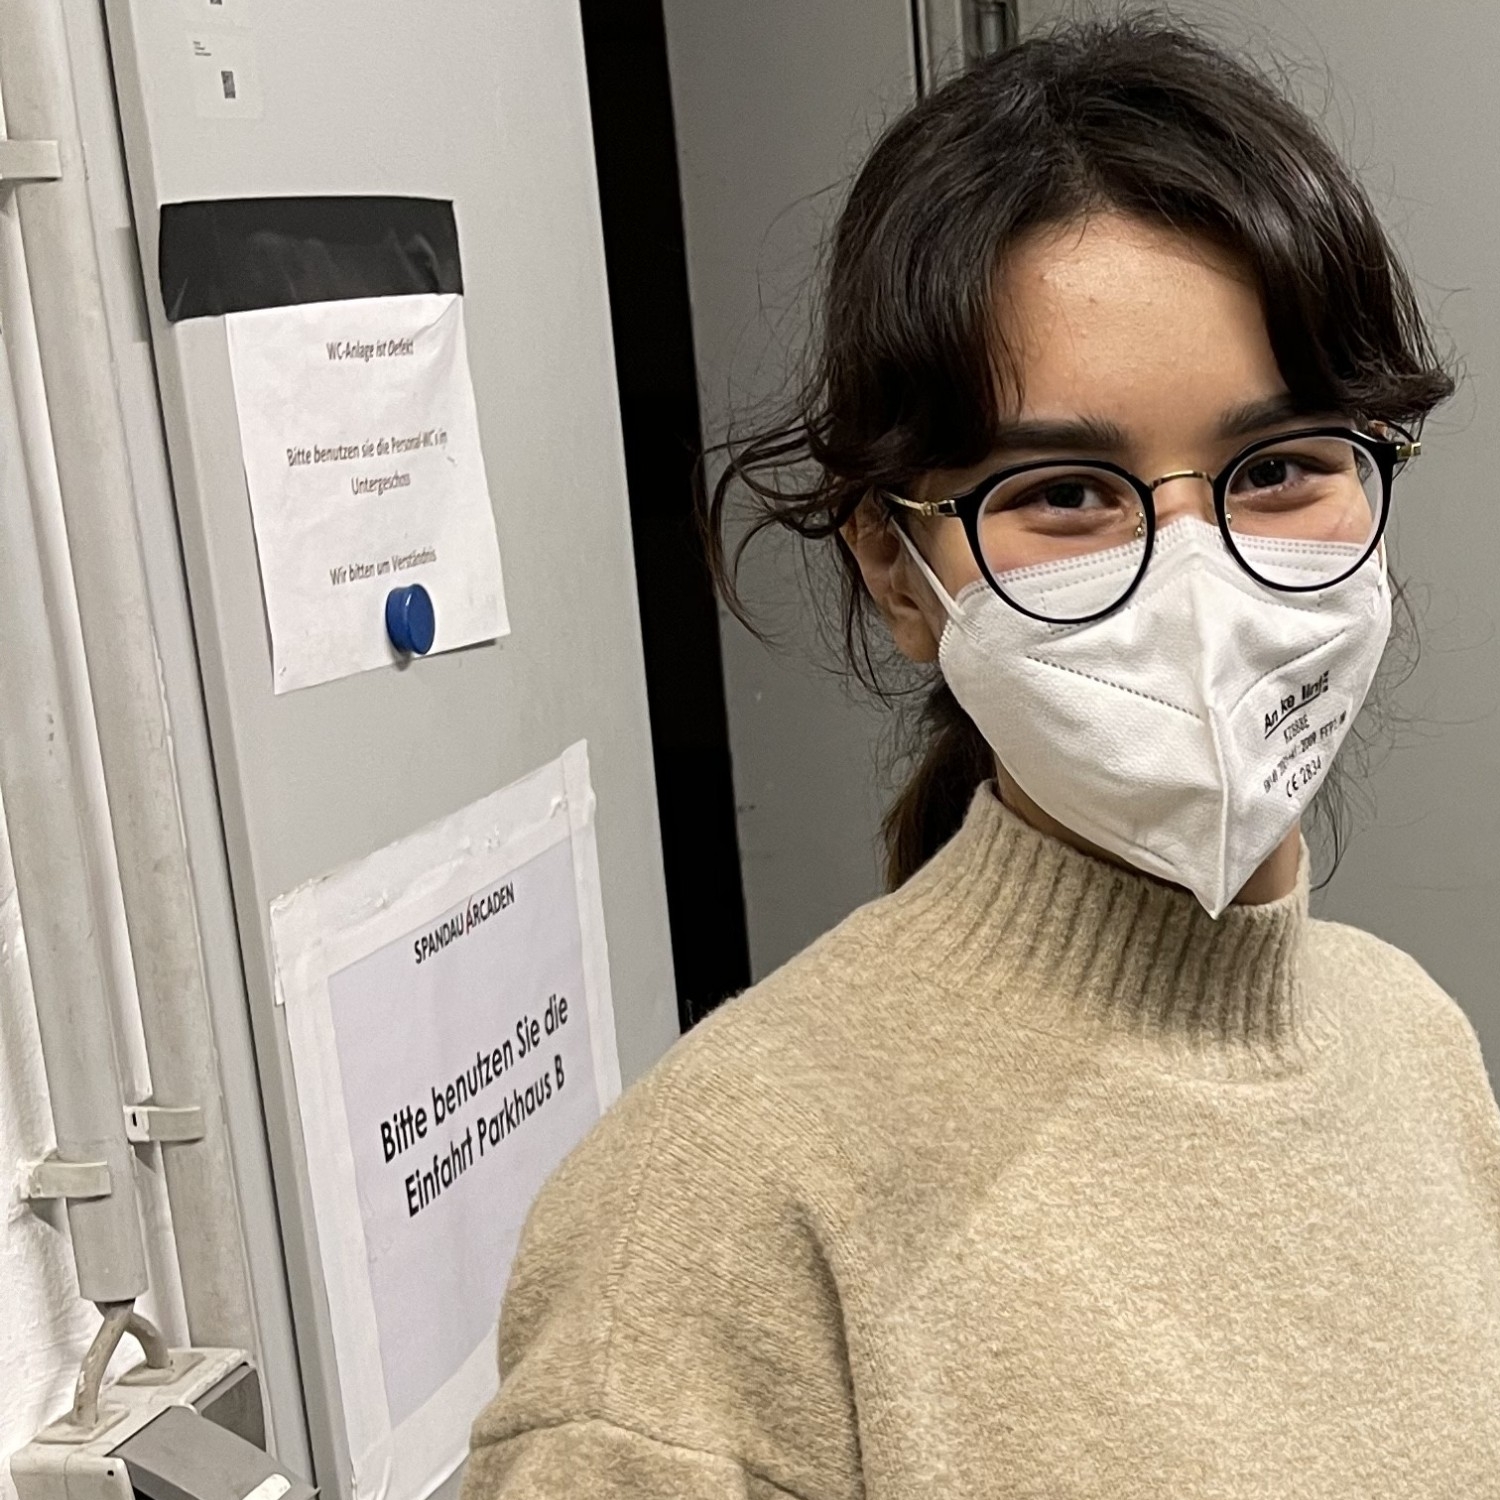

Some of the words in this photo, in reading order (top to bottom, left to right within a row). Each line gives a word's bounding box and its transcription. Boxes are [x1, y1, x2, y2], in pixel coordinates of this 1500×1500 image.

[326, 340, 374, 362] WC-Anlage
[376, 340, 386, 357] ist
[287, 446, 311, 466] Bitte
[314, 443, 359, 463] benutzen
[361, 438, 374, 458] sie
[377, 437, 389, 457] die
[351, 470, 411, 496] Untergeschoss
[329, 566, 346, 586] Wir
[349, 563, 375, 582] bitten
[377, 561, 390, 576] um
[414, 912, 464, 964] SPANDAU
[464, 882, 515, 935] ARCADEN
[380, 1104, 428, 1164] Bitte
[432, 1039, 514, 1127] benutzen
[516, 1015, 541, 1059] Sie
[544, 993, 569, 1036] die
[404, 1127, 474, 1218] Einfahrt
[476, 1069, 552, 1157] Parkhaus
[554, 1053, 566, 1091] B
